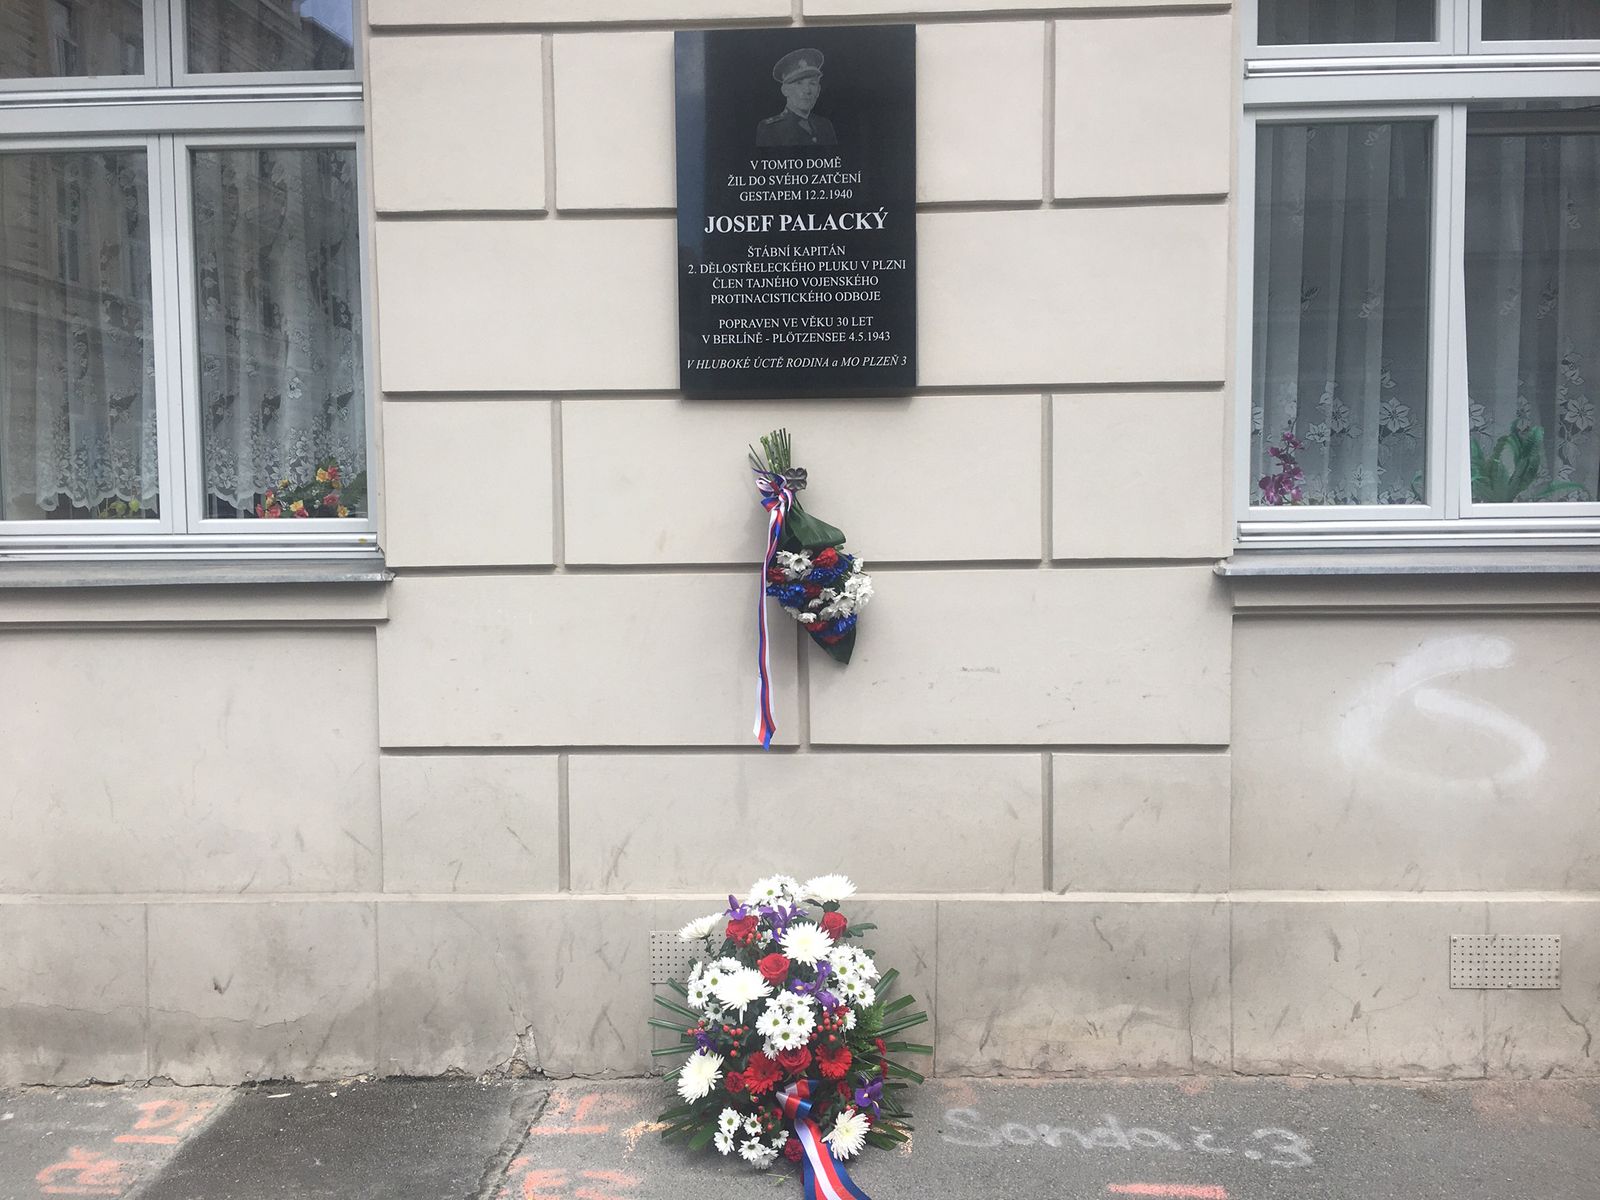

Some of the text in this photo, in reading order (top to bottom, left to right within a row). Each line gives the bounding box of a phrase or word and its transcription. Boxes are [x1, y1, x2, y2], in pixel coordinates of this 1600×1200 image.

[750, 156, 841, 170] V TOMTO DOMĚ
[728, 171, 861, 186] ŽIL DO SVÉHO ZATČENÍ
[740, 189, 852, 201] GESTAPEM 12.2.1940
[704, 207, 888, 233] JOSEF PALACKÝ
[748, 243, 845, 257] ŠTÁBNÍ KAPITÁN
[688, 260, 905, 274] 2. DĚLOSTŘELECKÉHO PLUKU V PLZNI
[713, 274, 878, 289] ČLEN TAJNÉHO VOJENSKÉHO
[711, 290, 880, 304] PROTINACISTICKÉHO ODBOJE
[719, 316, 873, 329] POPRAVEN VE VĚKU 30 LET
[702, 335, 710, 343] V
[713, 332, 762, 344] BERLÍNĚ
[773, 332, 846, 343] PLÖTZENSEE
[849, 331, 890, 341] 4.5.1943
[688, 360, 695, 369] V
[696, 357, 750, 369] HLUBOKÉ
[754, 356, 784, 368] ÚCTĚ
[786, 358, 828, 367] RODINA
[841, 357, 860, 366] MO
[862, 354, 899, 366] PLZEŇ
[901, 356, 907, 365] 3
